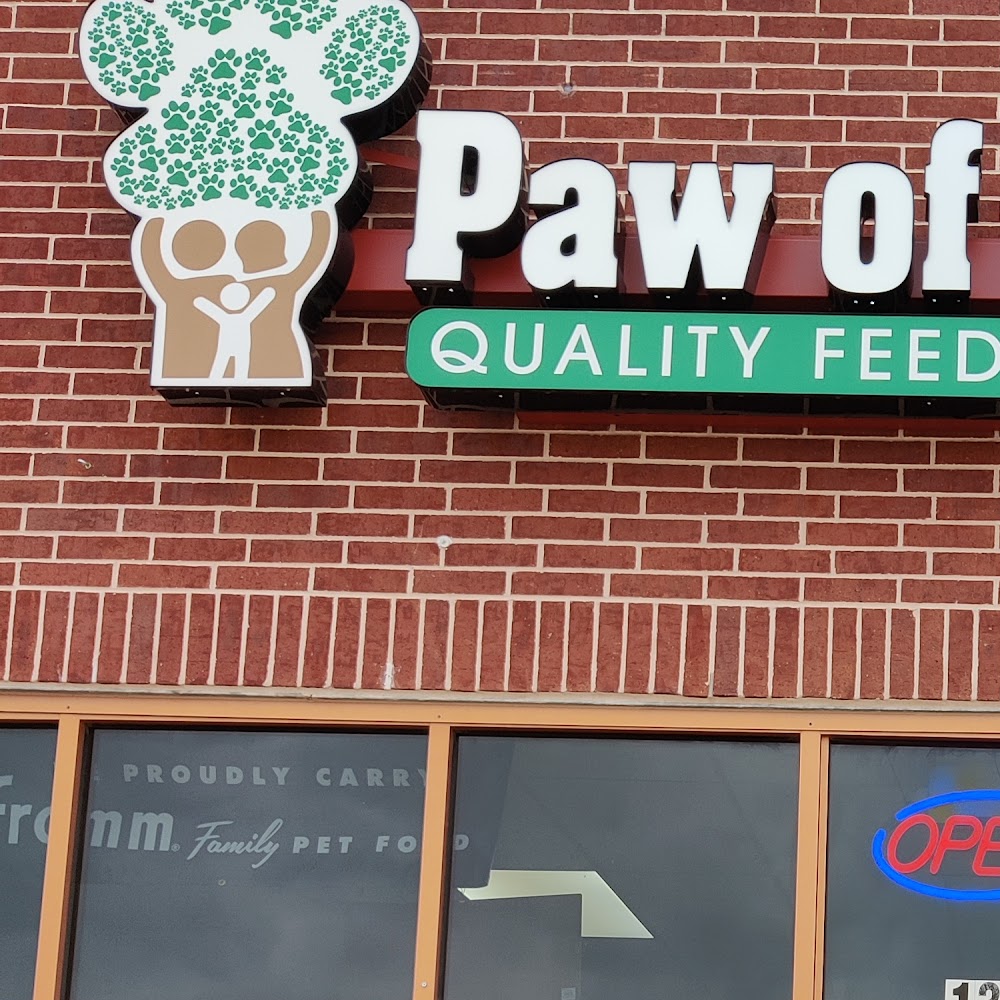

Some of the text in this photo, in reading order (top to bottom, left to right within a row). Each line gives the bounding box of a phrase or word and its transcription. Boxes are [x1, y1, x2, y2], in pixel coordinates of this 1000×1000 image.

[405, 109, 775, 291] Paw
[820, 118, 984, 295] of
[430, 320, 771, 379] QUALITY
[123, 764, 290, 787] PROUDLY
[186, 818, 284, 869] Family
[292, 836, 353, 854] PET
[375, 835, 470, 854] FOD
